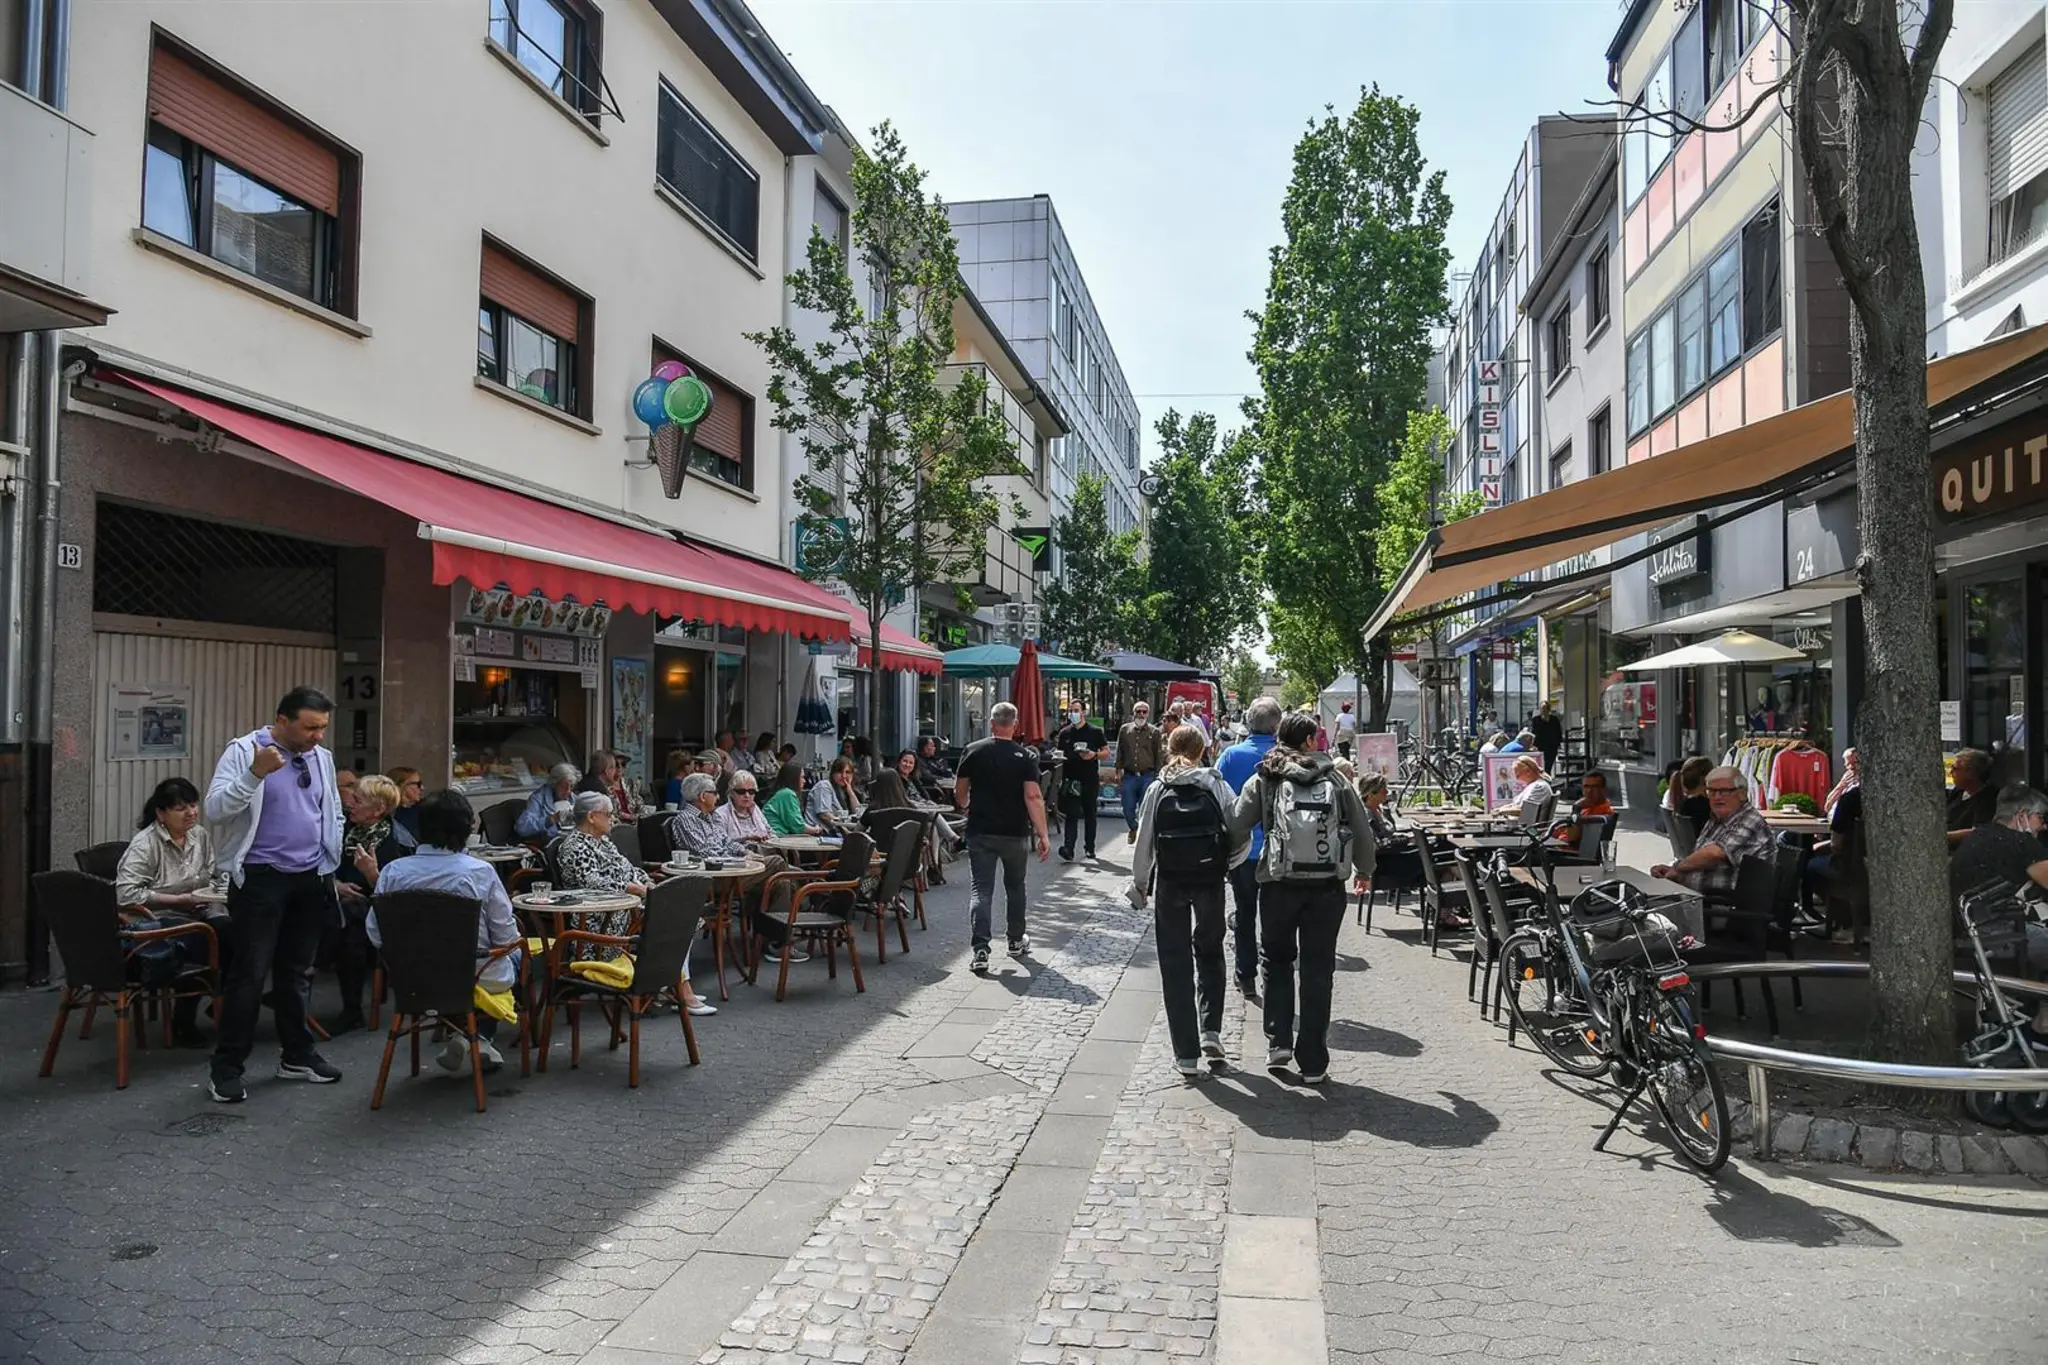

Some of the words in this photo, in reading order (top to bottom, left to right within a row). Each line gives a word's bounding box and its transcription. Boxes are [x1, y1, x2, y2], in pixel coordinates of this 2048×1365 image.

[1941, 433, 2048, 513] QUIT
[60, 545, 78, 566] 13
[1797, 546, 1814, 581] 24
[341, 675, 376, 700] 13
[1311, 791, 1331, 863] BRTO
